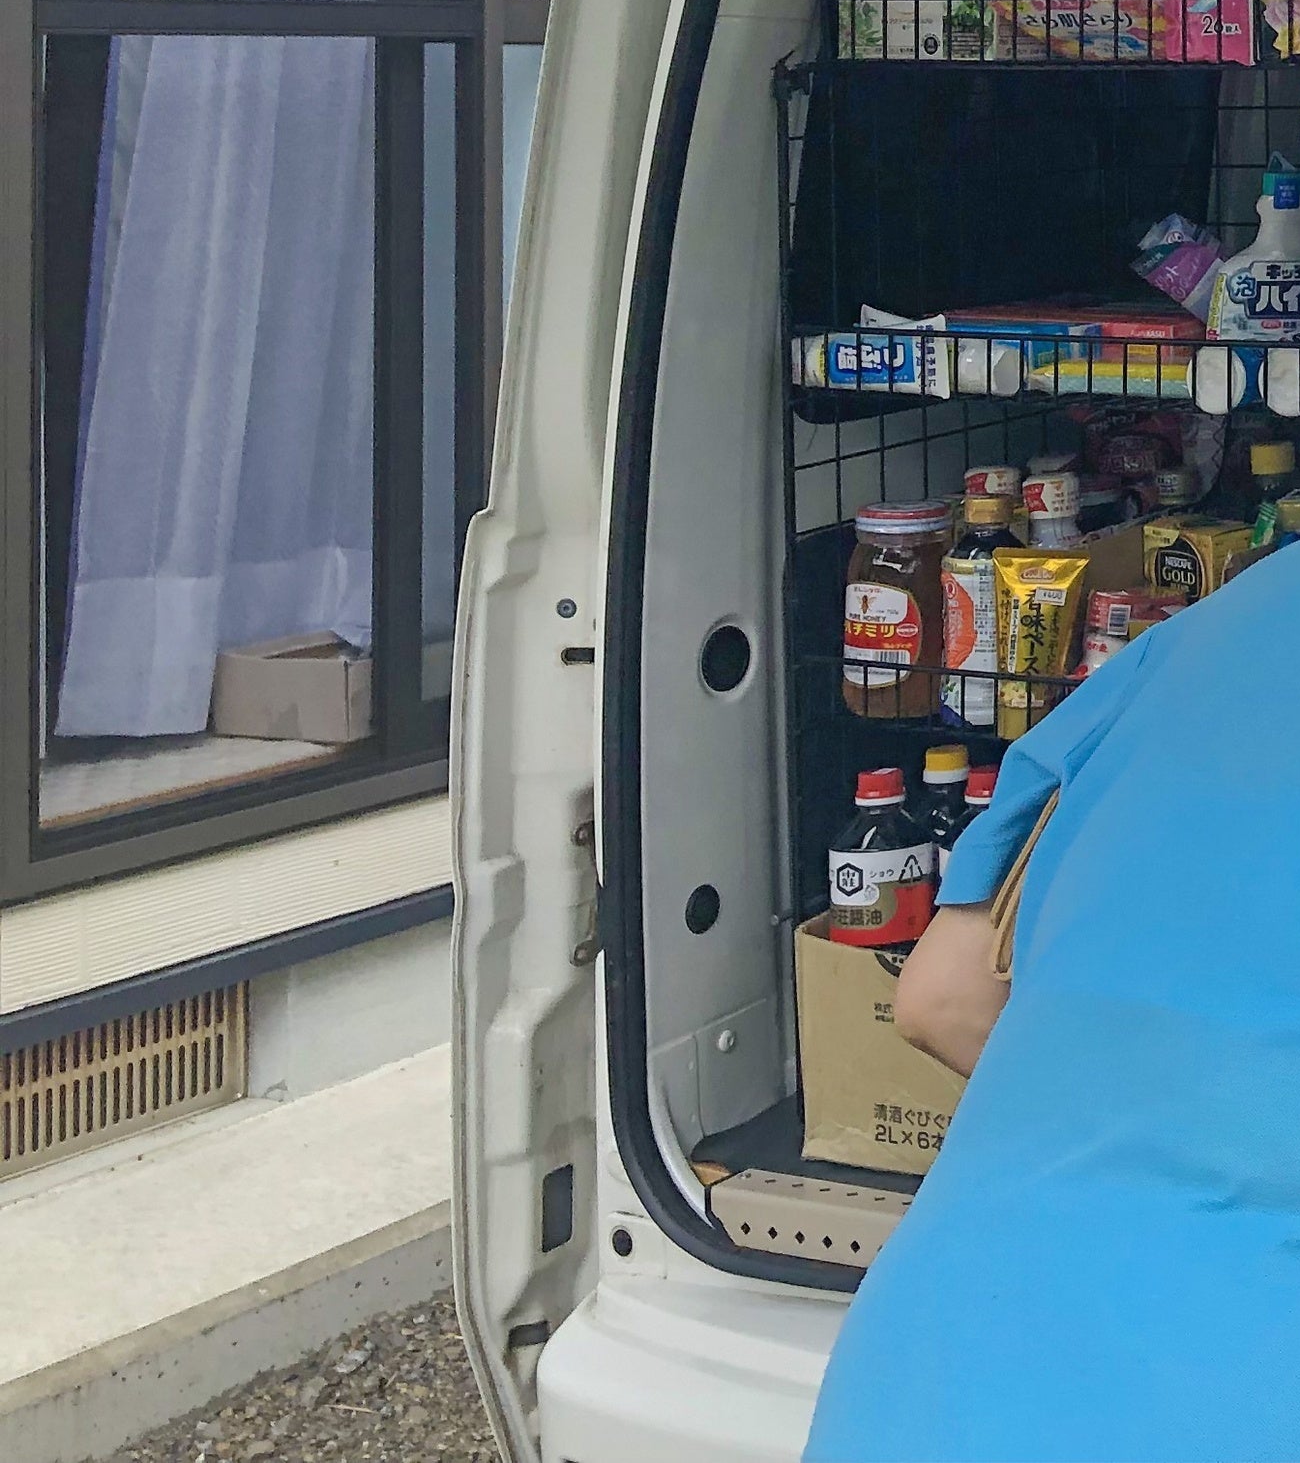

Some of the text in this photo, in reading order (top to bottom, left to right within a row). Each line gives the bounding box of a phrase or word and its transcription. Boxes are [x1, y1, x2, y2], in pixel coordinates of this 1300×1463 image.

[1233, 275, 1257, 298] 泡
[1161, 567, 1196, 586] GOLD
[869, 868, 896, 879] ショウ
[873, 1103, 952, 1131] 清酒ぐびぐ
